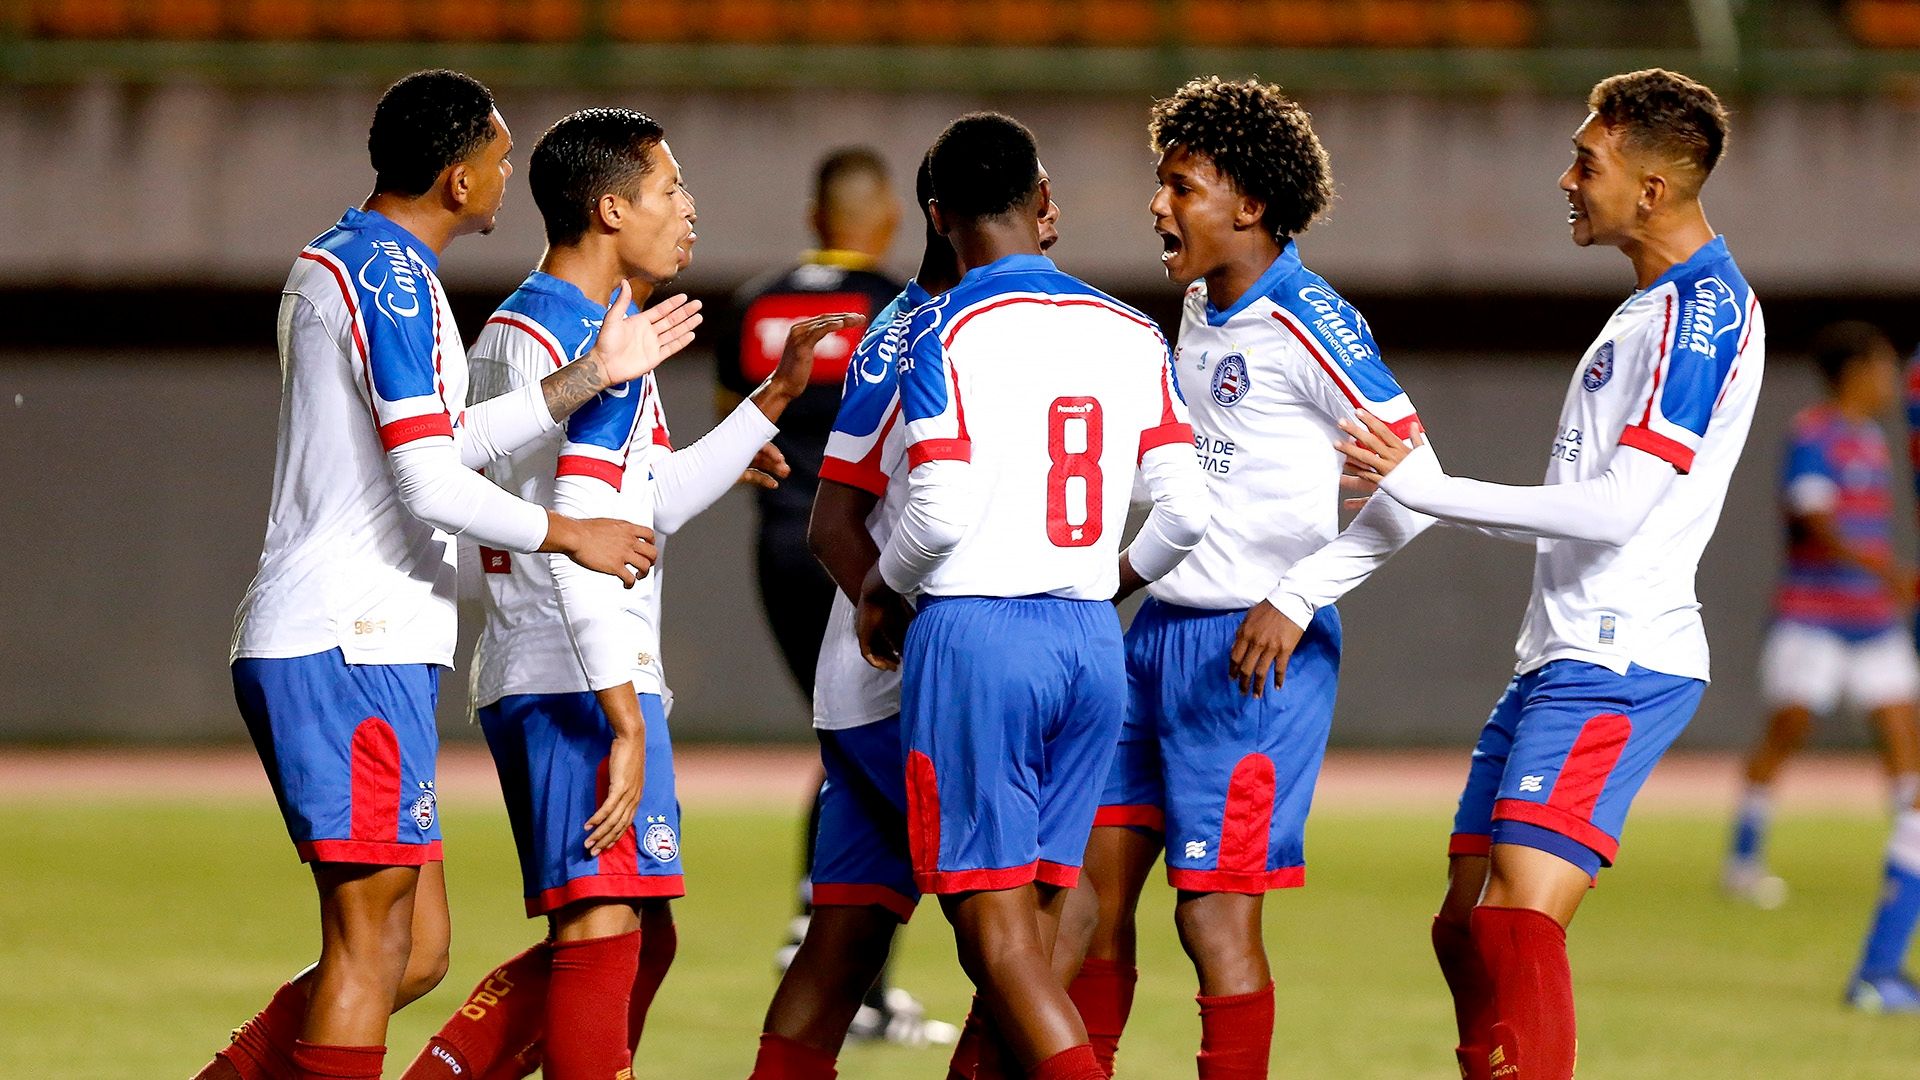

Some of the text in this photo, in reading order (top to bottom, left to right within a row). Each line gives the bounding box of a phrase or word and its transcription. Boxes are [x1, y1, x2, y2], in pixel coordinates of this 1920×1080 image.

[1299, 286, 1374, 361] Canaã
[1312, 318, 1355, 368] Alimentos
[1690, 277, 1725, 358] Canaã
[1046, 396, 1103, 547] 8
[1212, 440, 1235, 456] DE
[431, 1045, 462, 1076] LUPO
